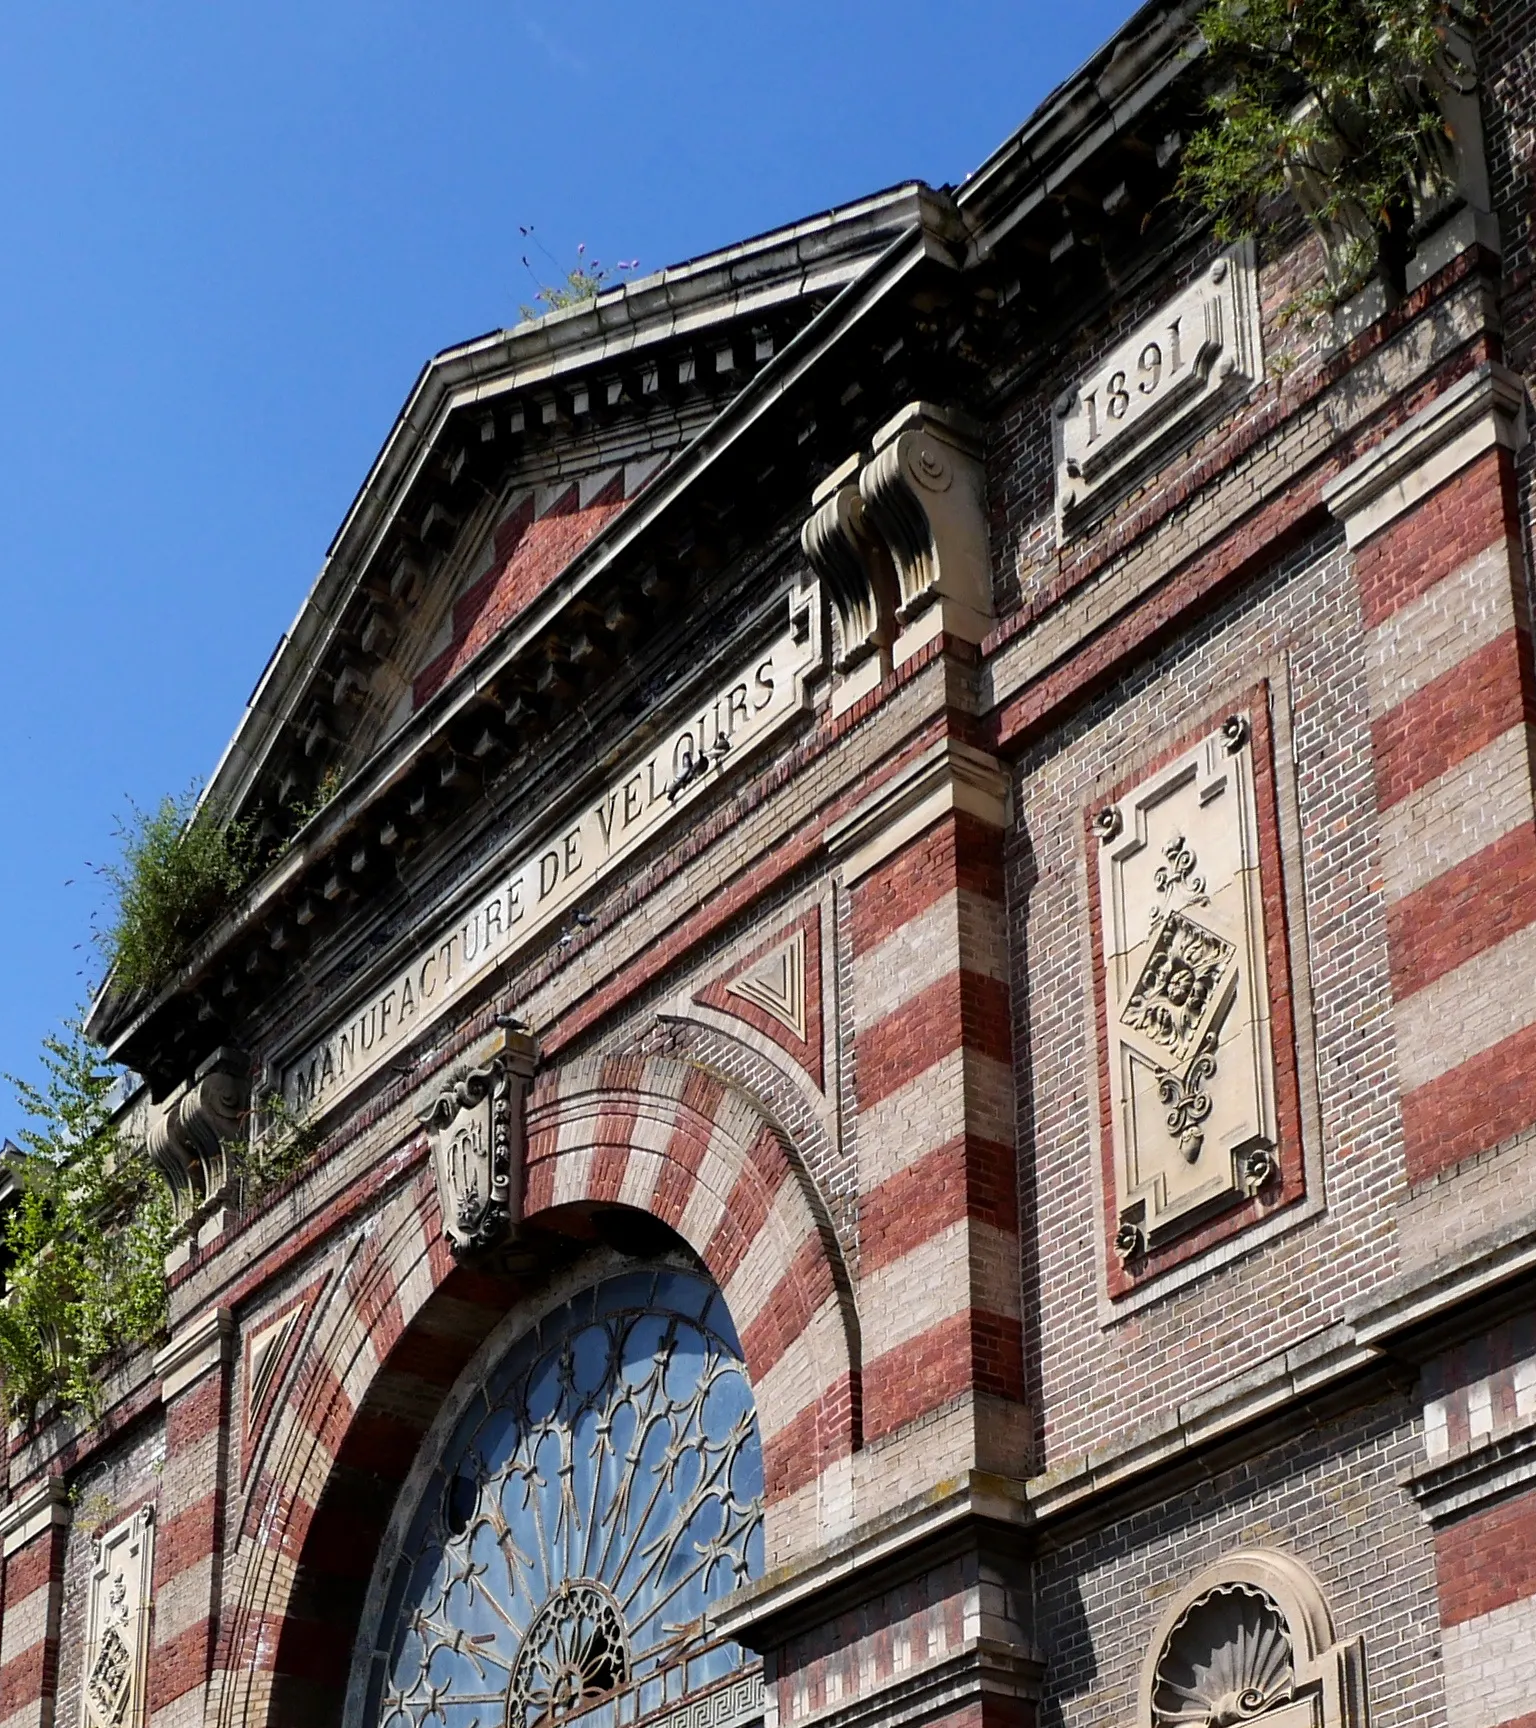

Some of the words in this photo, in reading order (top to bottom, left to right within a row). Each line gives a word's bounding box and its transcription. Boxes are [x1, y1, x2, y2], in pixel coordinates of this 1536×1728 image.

[1084, 316, 1185, 447] 1891
[296, 873, 524, 1112] MANUFACTURE
[537, 826, 583, 904] DE
